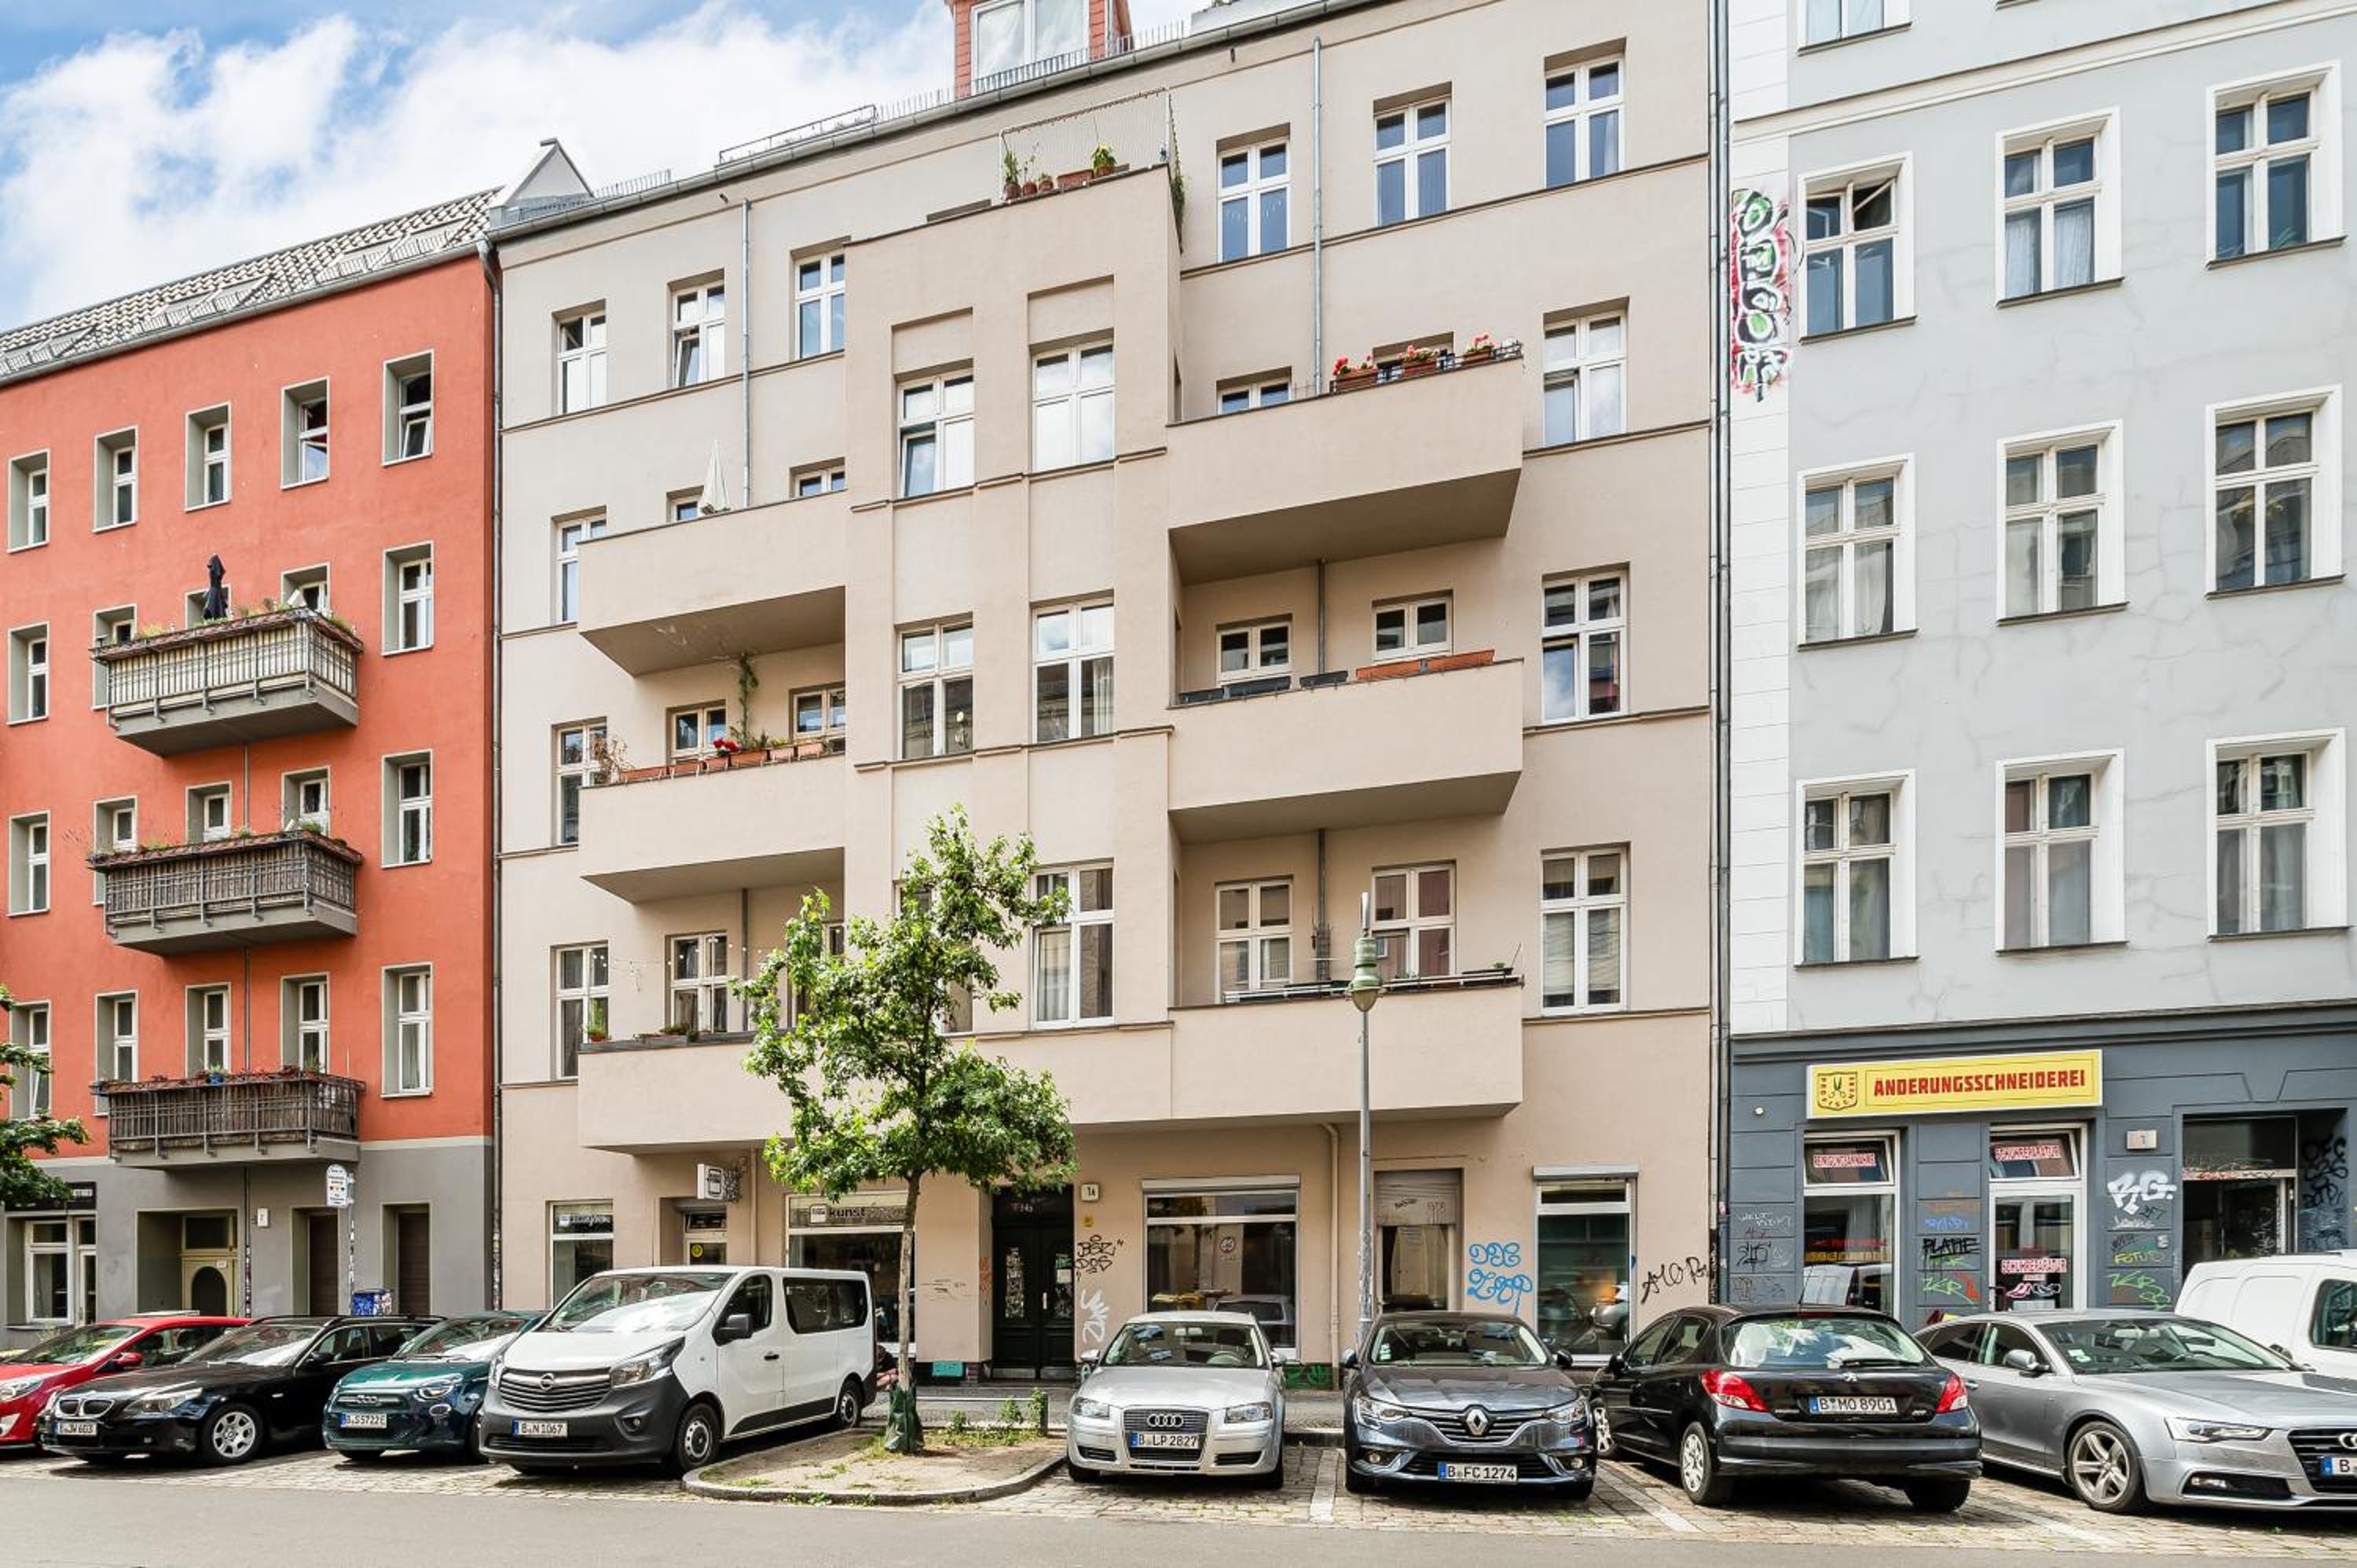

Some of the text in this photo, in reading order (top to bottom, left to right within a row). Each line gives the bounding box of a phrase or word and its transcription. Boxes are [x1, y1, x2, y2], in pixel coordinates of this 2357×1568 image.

[1819, 1398, 1895, 1411] B MO 8901
[1153, 1435, 1167, 1446] LP
[1448, 1465, 1516, 1480] B FC 1274
[2339, 1459, 2350, 1473] B
